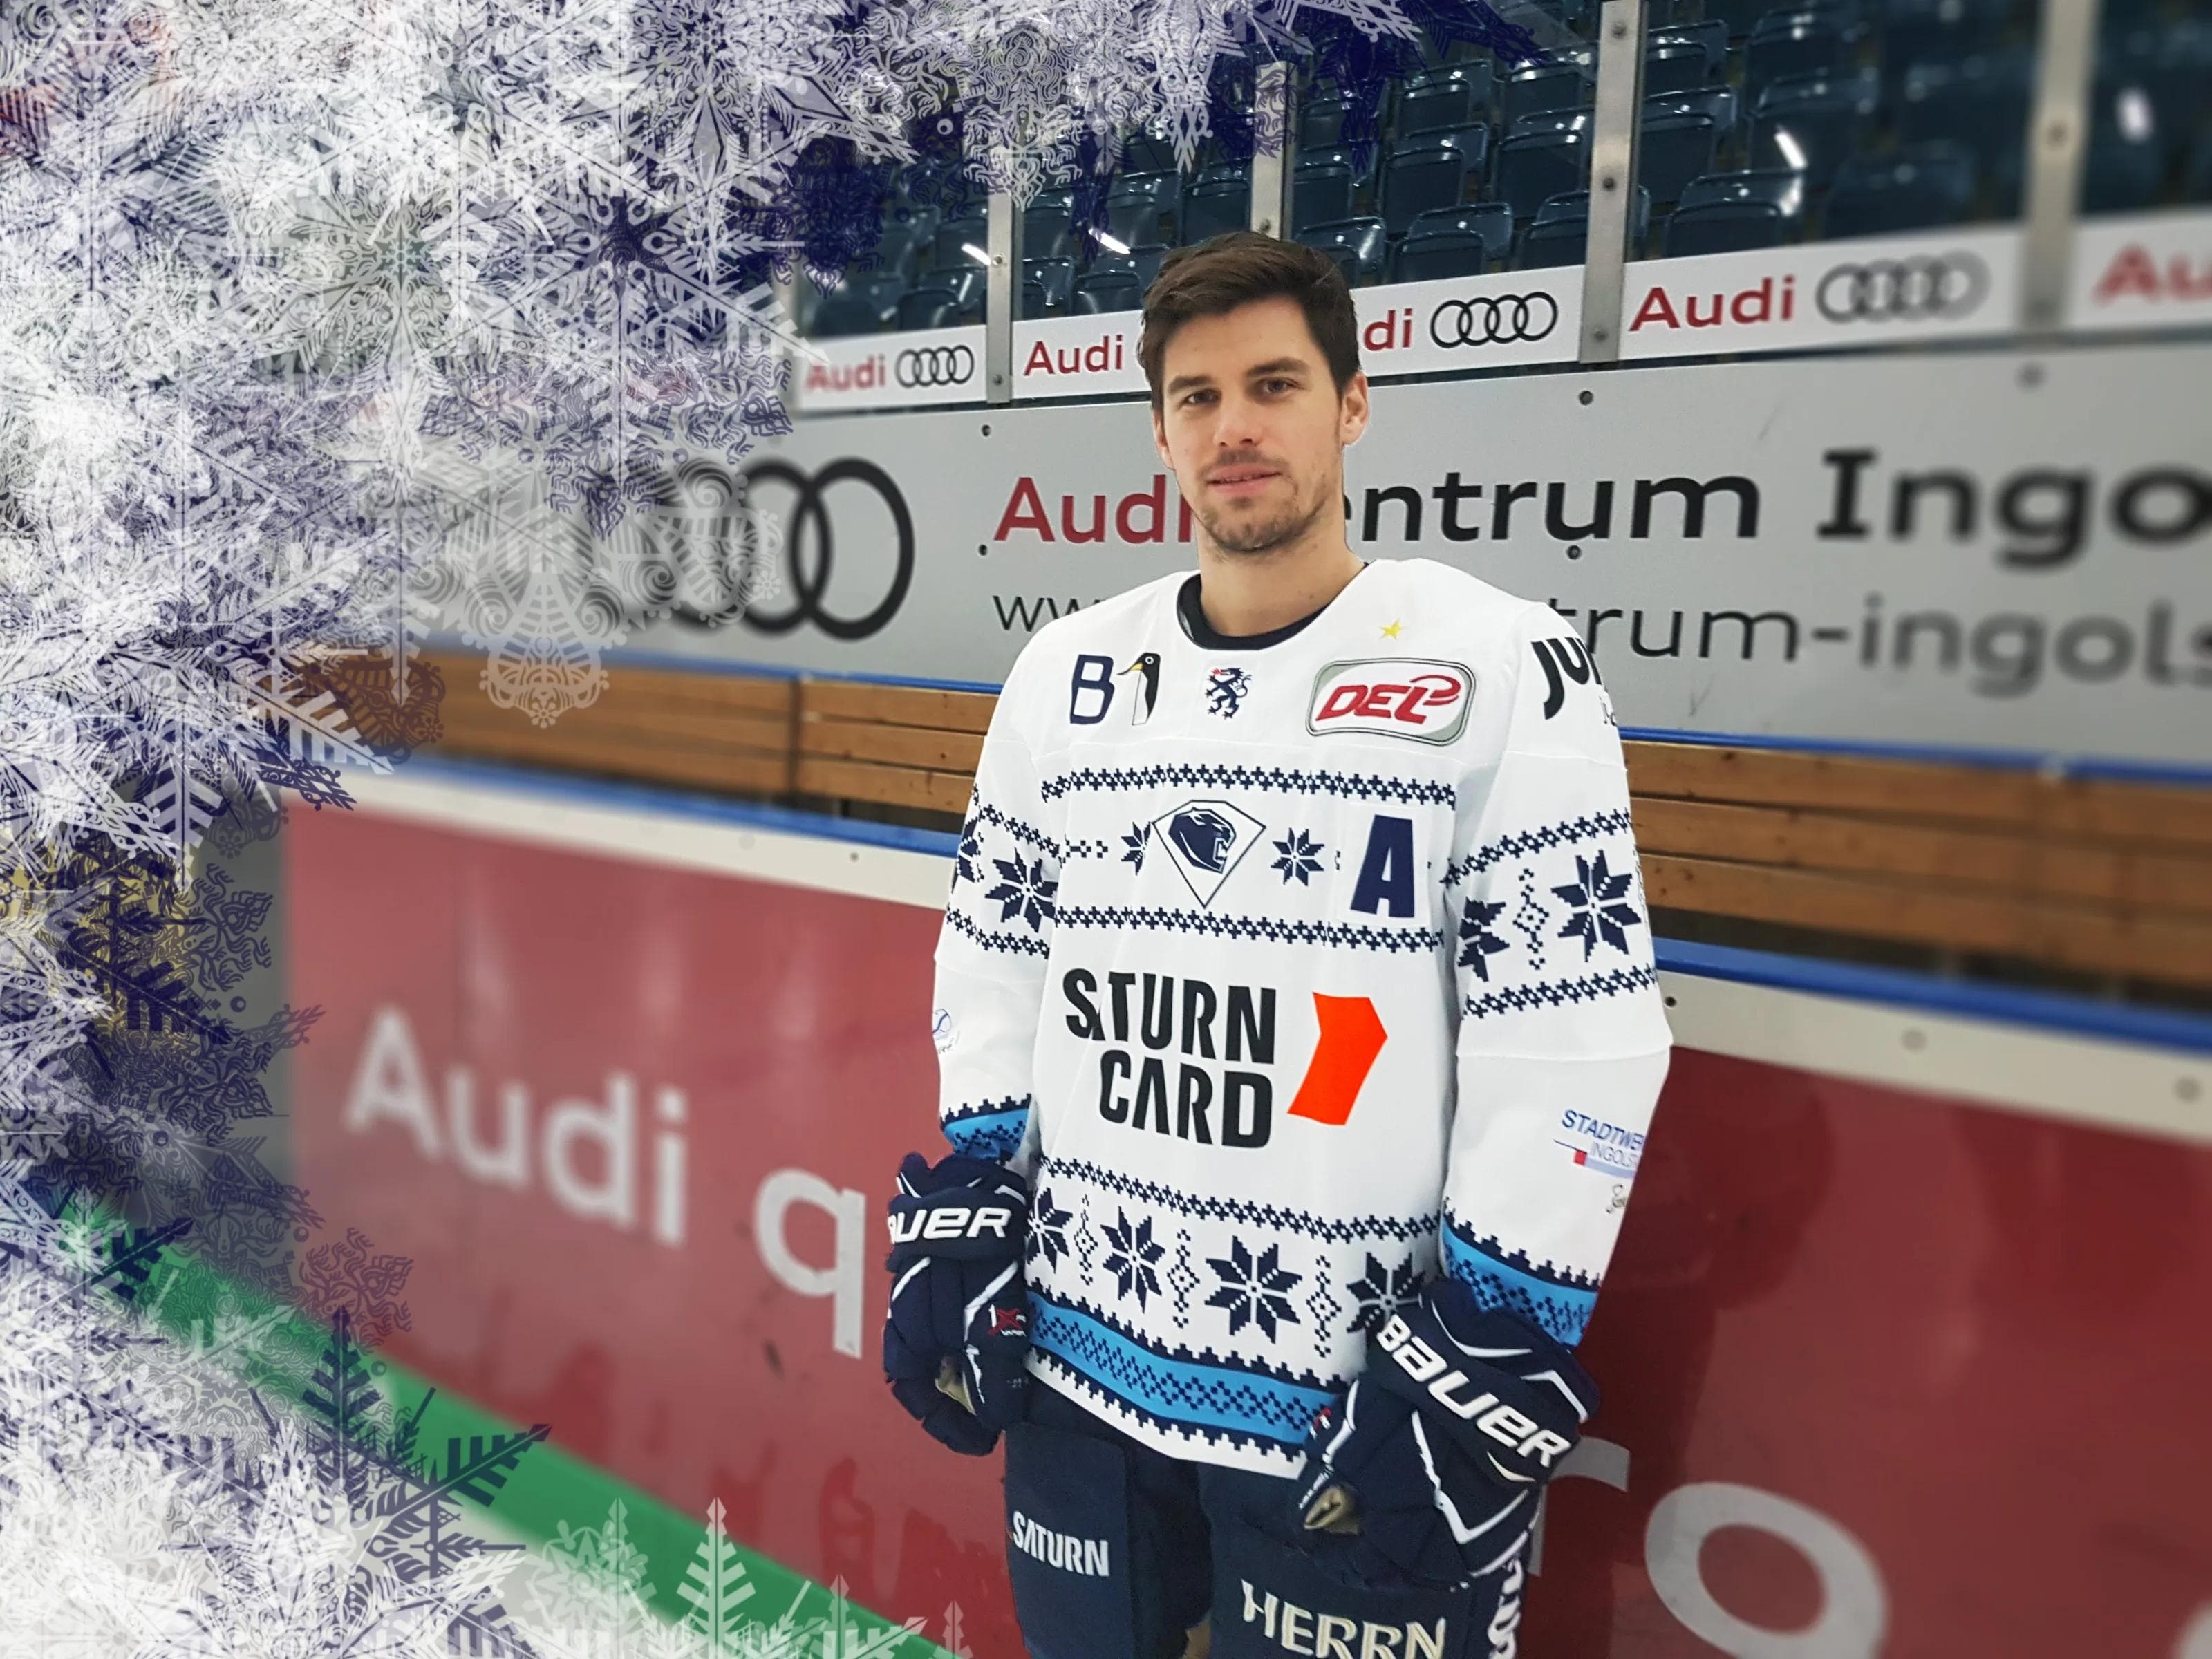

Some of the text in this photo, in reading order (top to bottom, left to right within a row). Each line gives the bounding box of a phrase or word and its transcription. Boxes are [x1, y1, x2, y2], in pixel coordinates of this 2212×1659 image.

[1363, 308, 1413, 351] di
[1628, 274, 1796, 332] Audi
[803, 353, 887, 392] Audi
[1024, 335, 1123, 375] Audi
[993, 447, 2212, 572] Audi ntrum Ingo
[1315, 675, 1461, 725] DEL
[1349, 814, 1416, 919] A
[344, 1006, 689, 1244] Audi
[1099, 1049, 1273, 1149] CARD
[1012, 1510, 1110, 1577] SATURN
[1241, 1579, 1447, 1659] HERRN
